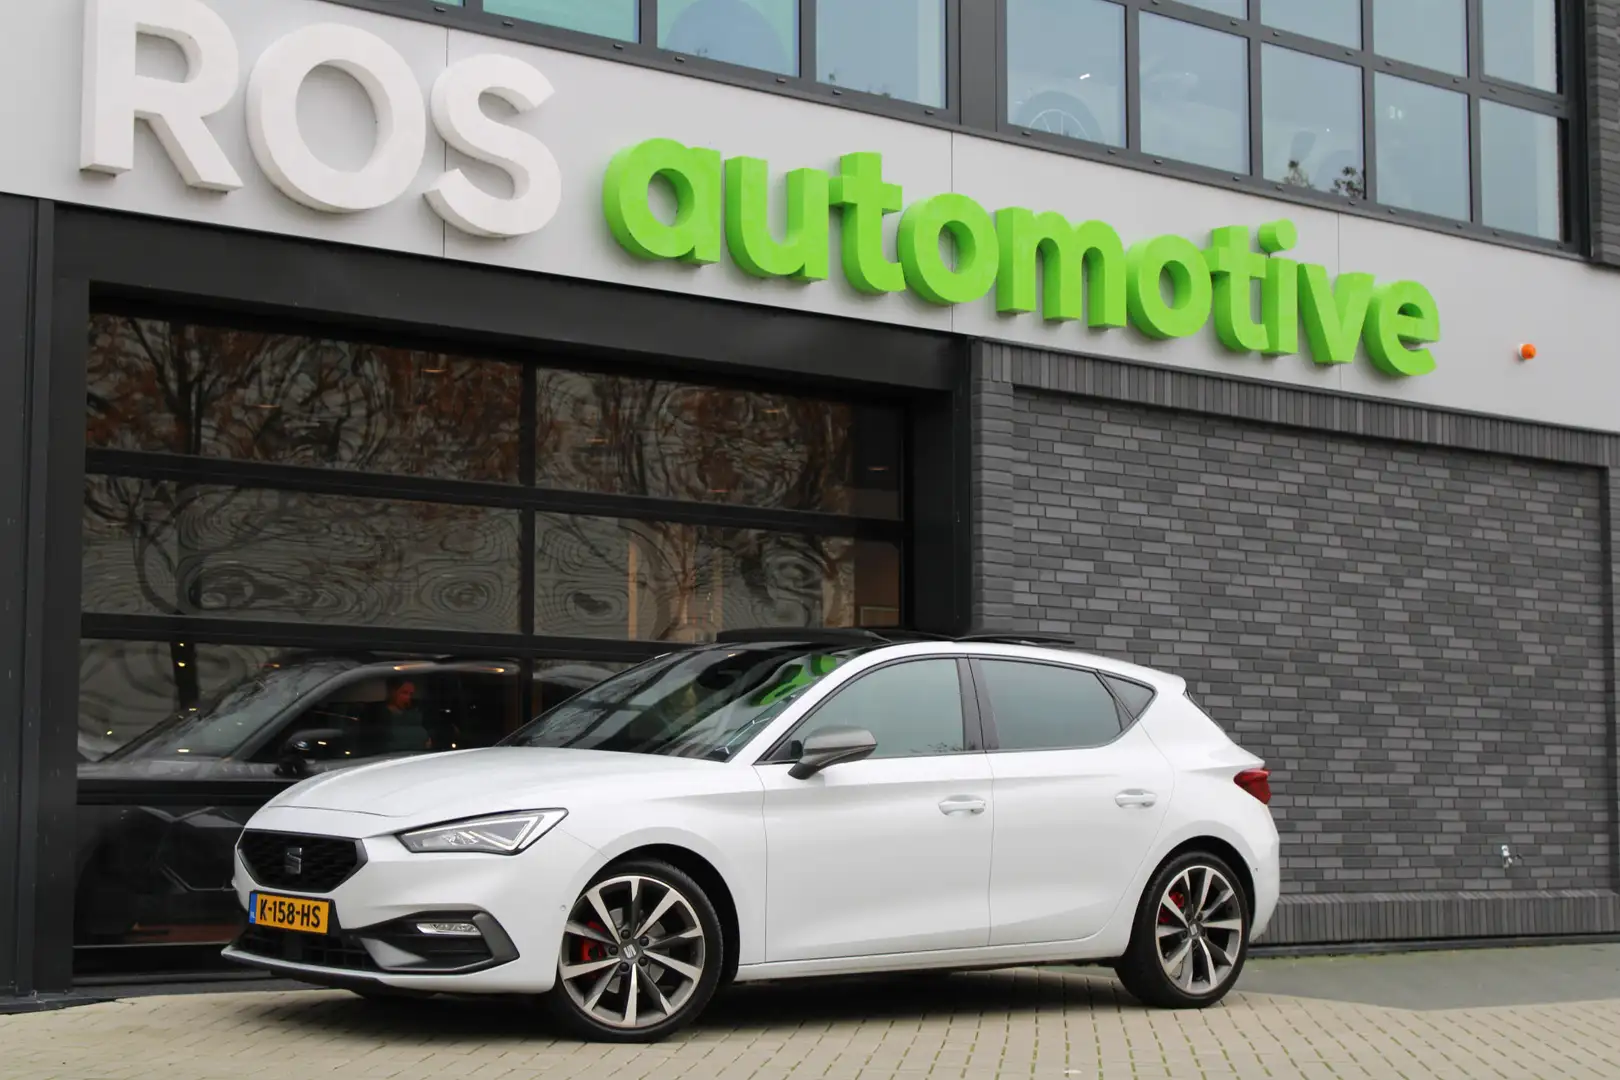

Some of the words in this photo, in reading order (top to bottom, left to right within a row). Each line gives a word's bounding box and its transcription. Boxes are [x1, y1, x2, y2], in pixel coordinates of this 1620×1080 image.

[80, 0, 562, 238] ROS
[603, 137, 1440, 377] automotive
[260, 899, 321, 928] K-158-HS
